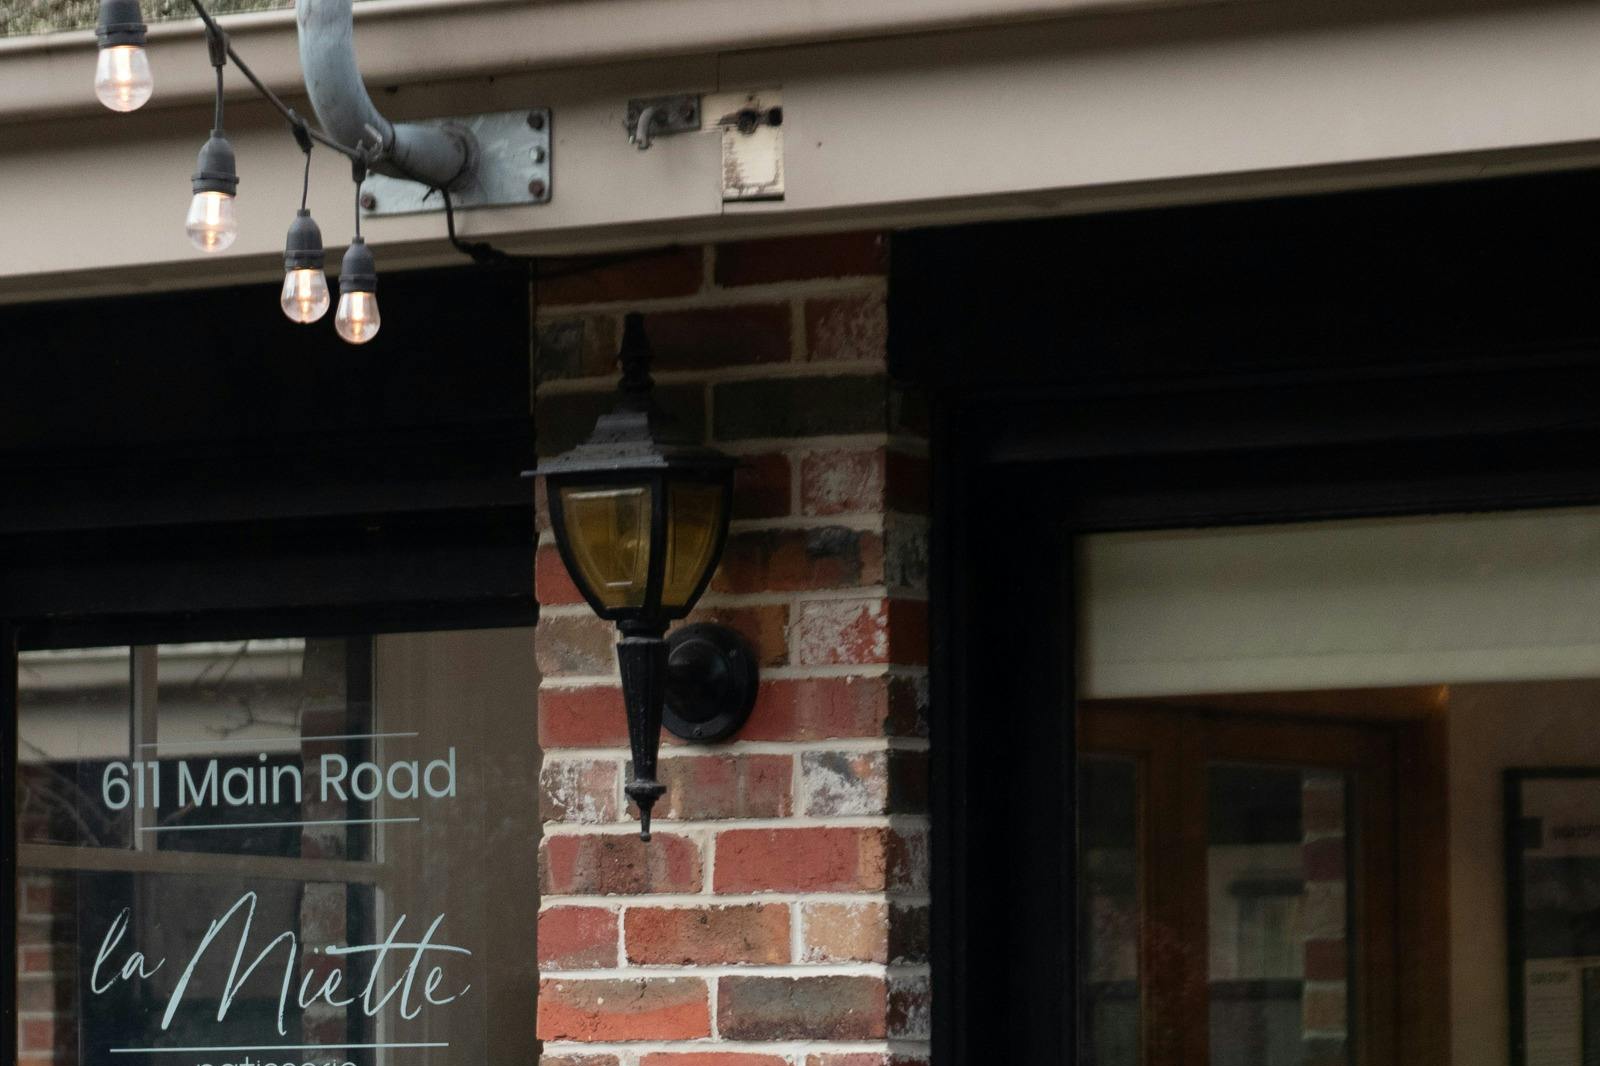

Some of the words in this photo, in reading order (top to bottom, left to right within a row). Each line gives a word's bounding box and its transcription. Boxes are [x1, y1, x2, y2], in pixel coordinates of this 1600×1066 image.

[102, 761, 160, 809] 611
[178, 753, 301, 807] Main
[320, 747, 457, 802] Road
[91, 906, 165, 994] la
[162, 891, 472, 1035] Miette
